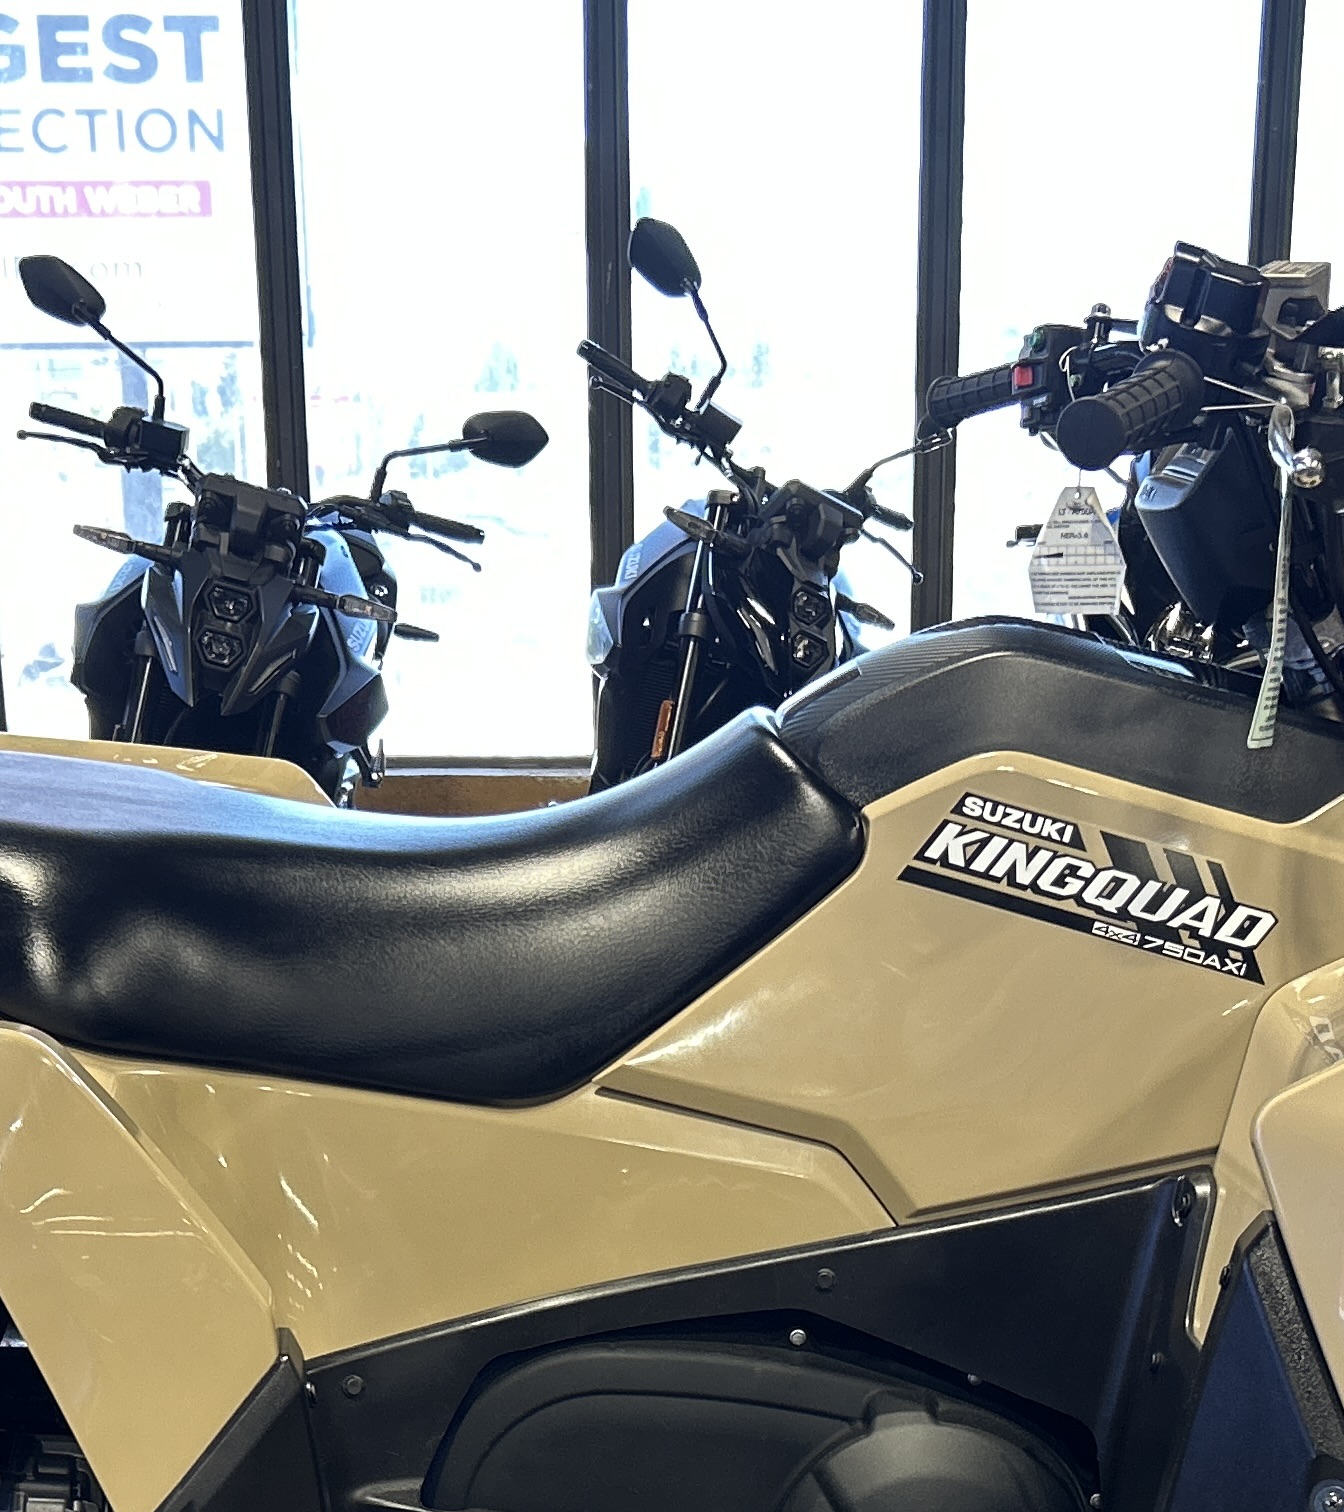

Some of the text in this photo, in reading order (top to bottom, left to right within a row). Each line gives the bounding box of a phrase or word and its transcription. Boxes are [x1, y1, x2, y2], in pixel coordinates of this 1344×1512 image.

[83, 182, 203, 214] WEBER
[961, 796, 1074, 843] SUZUKI
[923, 823, 1276, 949] KINGQUAD
